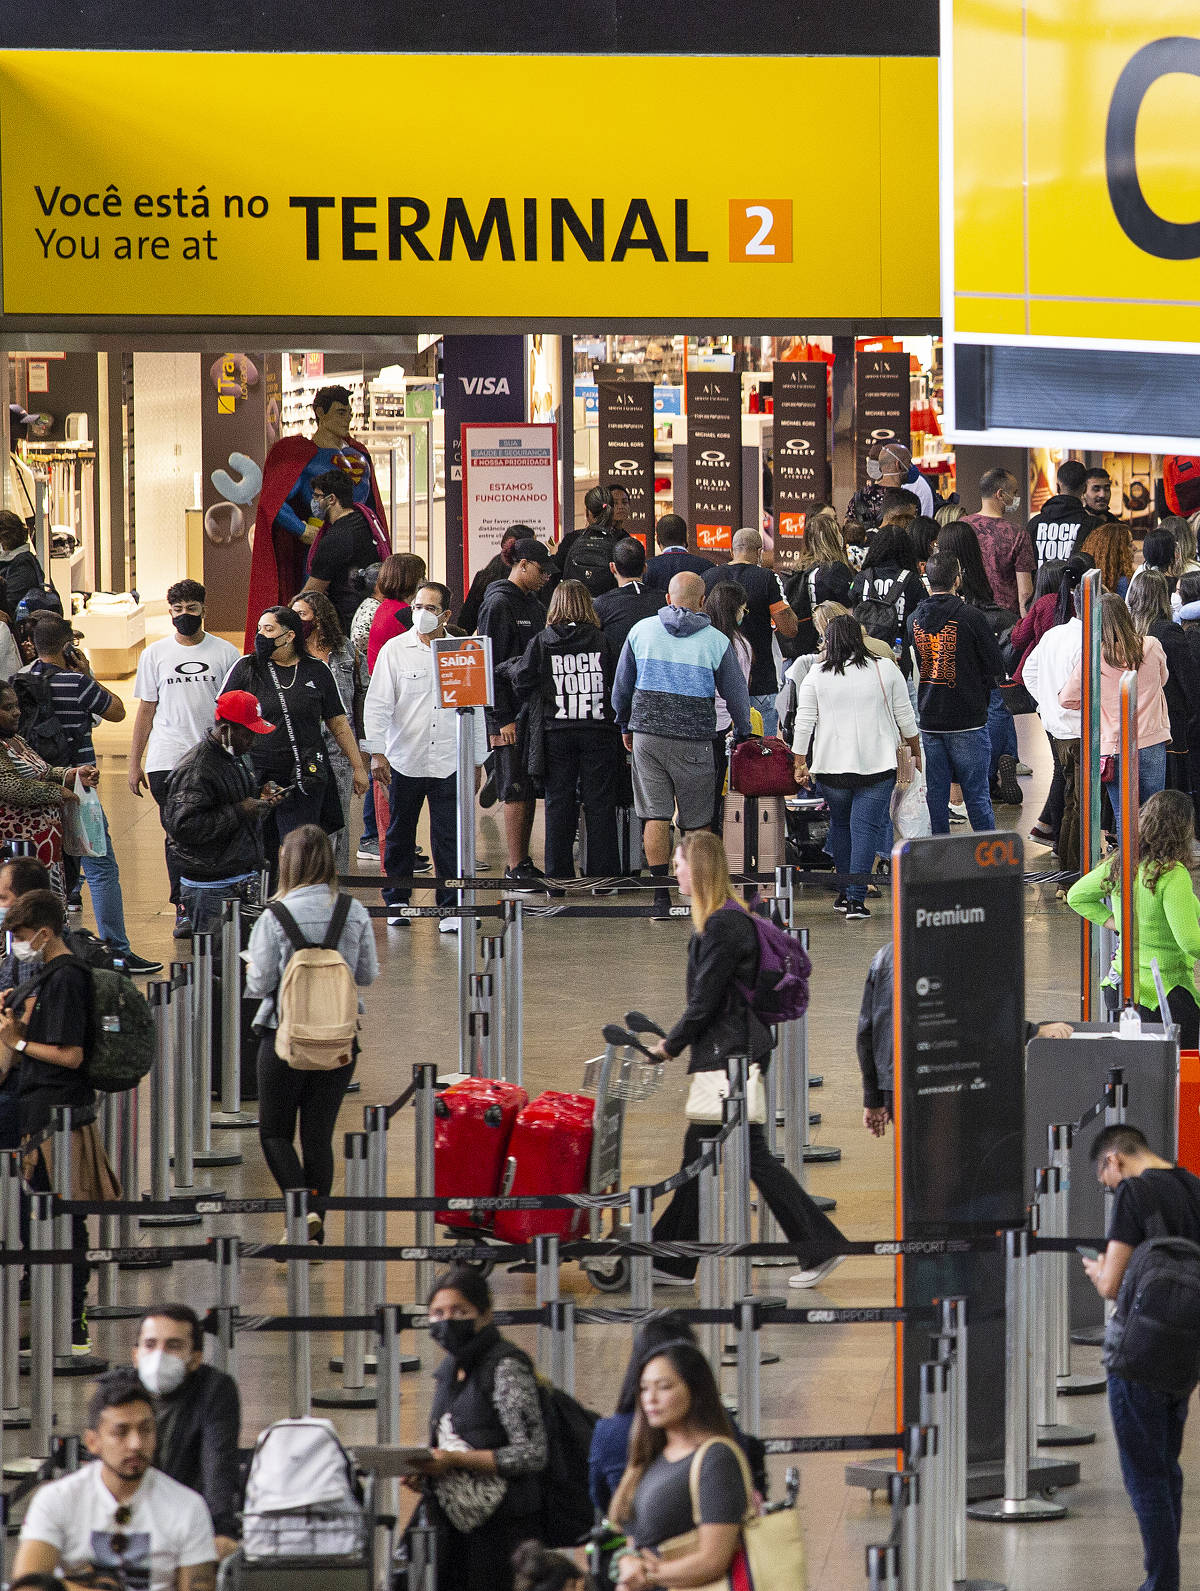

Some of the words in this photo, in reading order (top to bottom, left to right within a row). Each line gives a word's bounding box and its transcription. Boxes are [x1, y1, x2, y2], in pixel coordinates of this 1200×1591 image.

[33, 183, 123, 218] Você
[133, 184, 210, 219] está
[224, 195, 269, 219] no
[288, 196, 709, 263] TERMINAL
[744, 205, 776, 256] 2
[34, 227, 100, 260] You
[113, 236, 170, 260] are
[182, 229, 218, 261] at
[458, 377, 510, 395] VISA
[780, 467, 815, 476] PRADA
[695, 478, 731, 488] PRADA
[476, 494, 548, 502] FUNCIONANDO
[780, 491, 815, 500] RALPH
[695, 502, 732, 512] RALPH
[1036, 522, 1081, 541] ROCK
[440, 654, 476, 668] SAÍDA
[551, 652, 602, 675] ROCK
[166, 674, 218, 686] OAKLEY
[552, 672, 604, 696] YOUR
[554, 692, 605, 720] LIFE
[974, 840, 1019, 867] GOL
[444, 880, 500, 888] GRUAIRPORT
[400, 908, 456, 917] GRUAIRPORT
[916, 904, 986, 928] Premium
[874, 1241, 945, 1255] GRUAIRPORT
[806, 1309, 881, 1323] GRUAIRPORT
